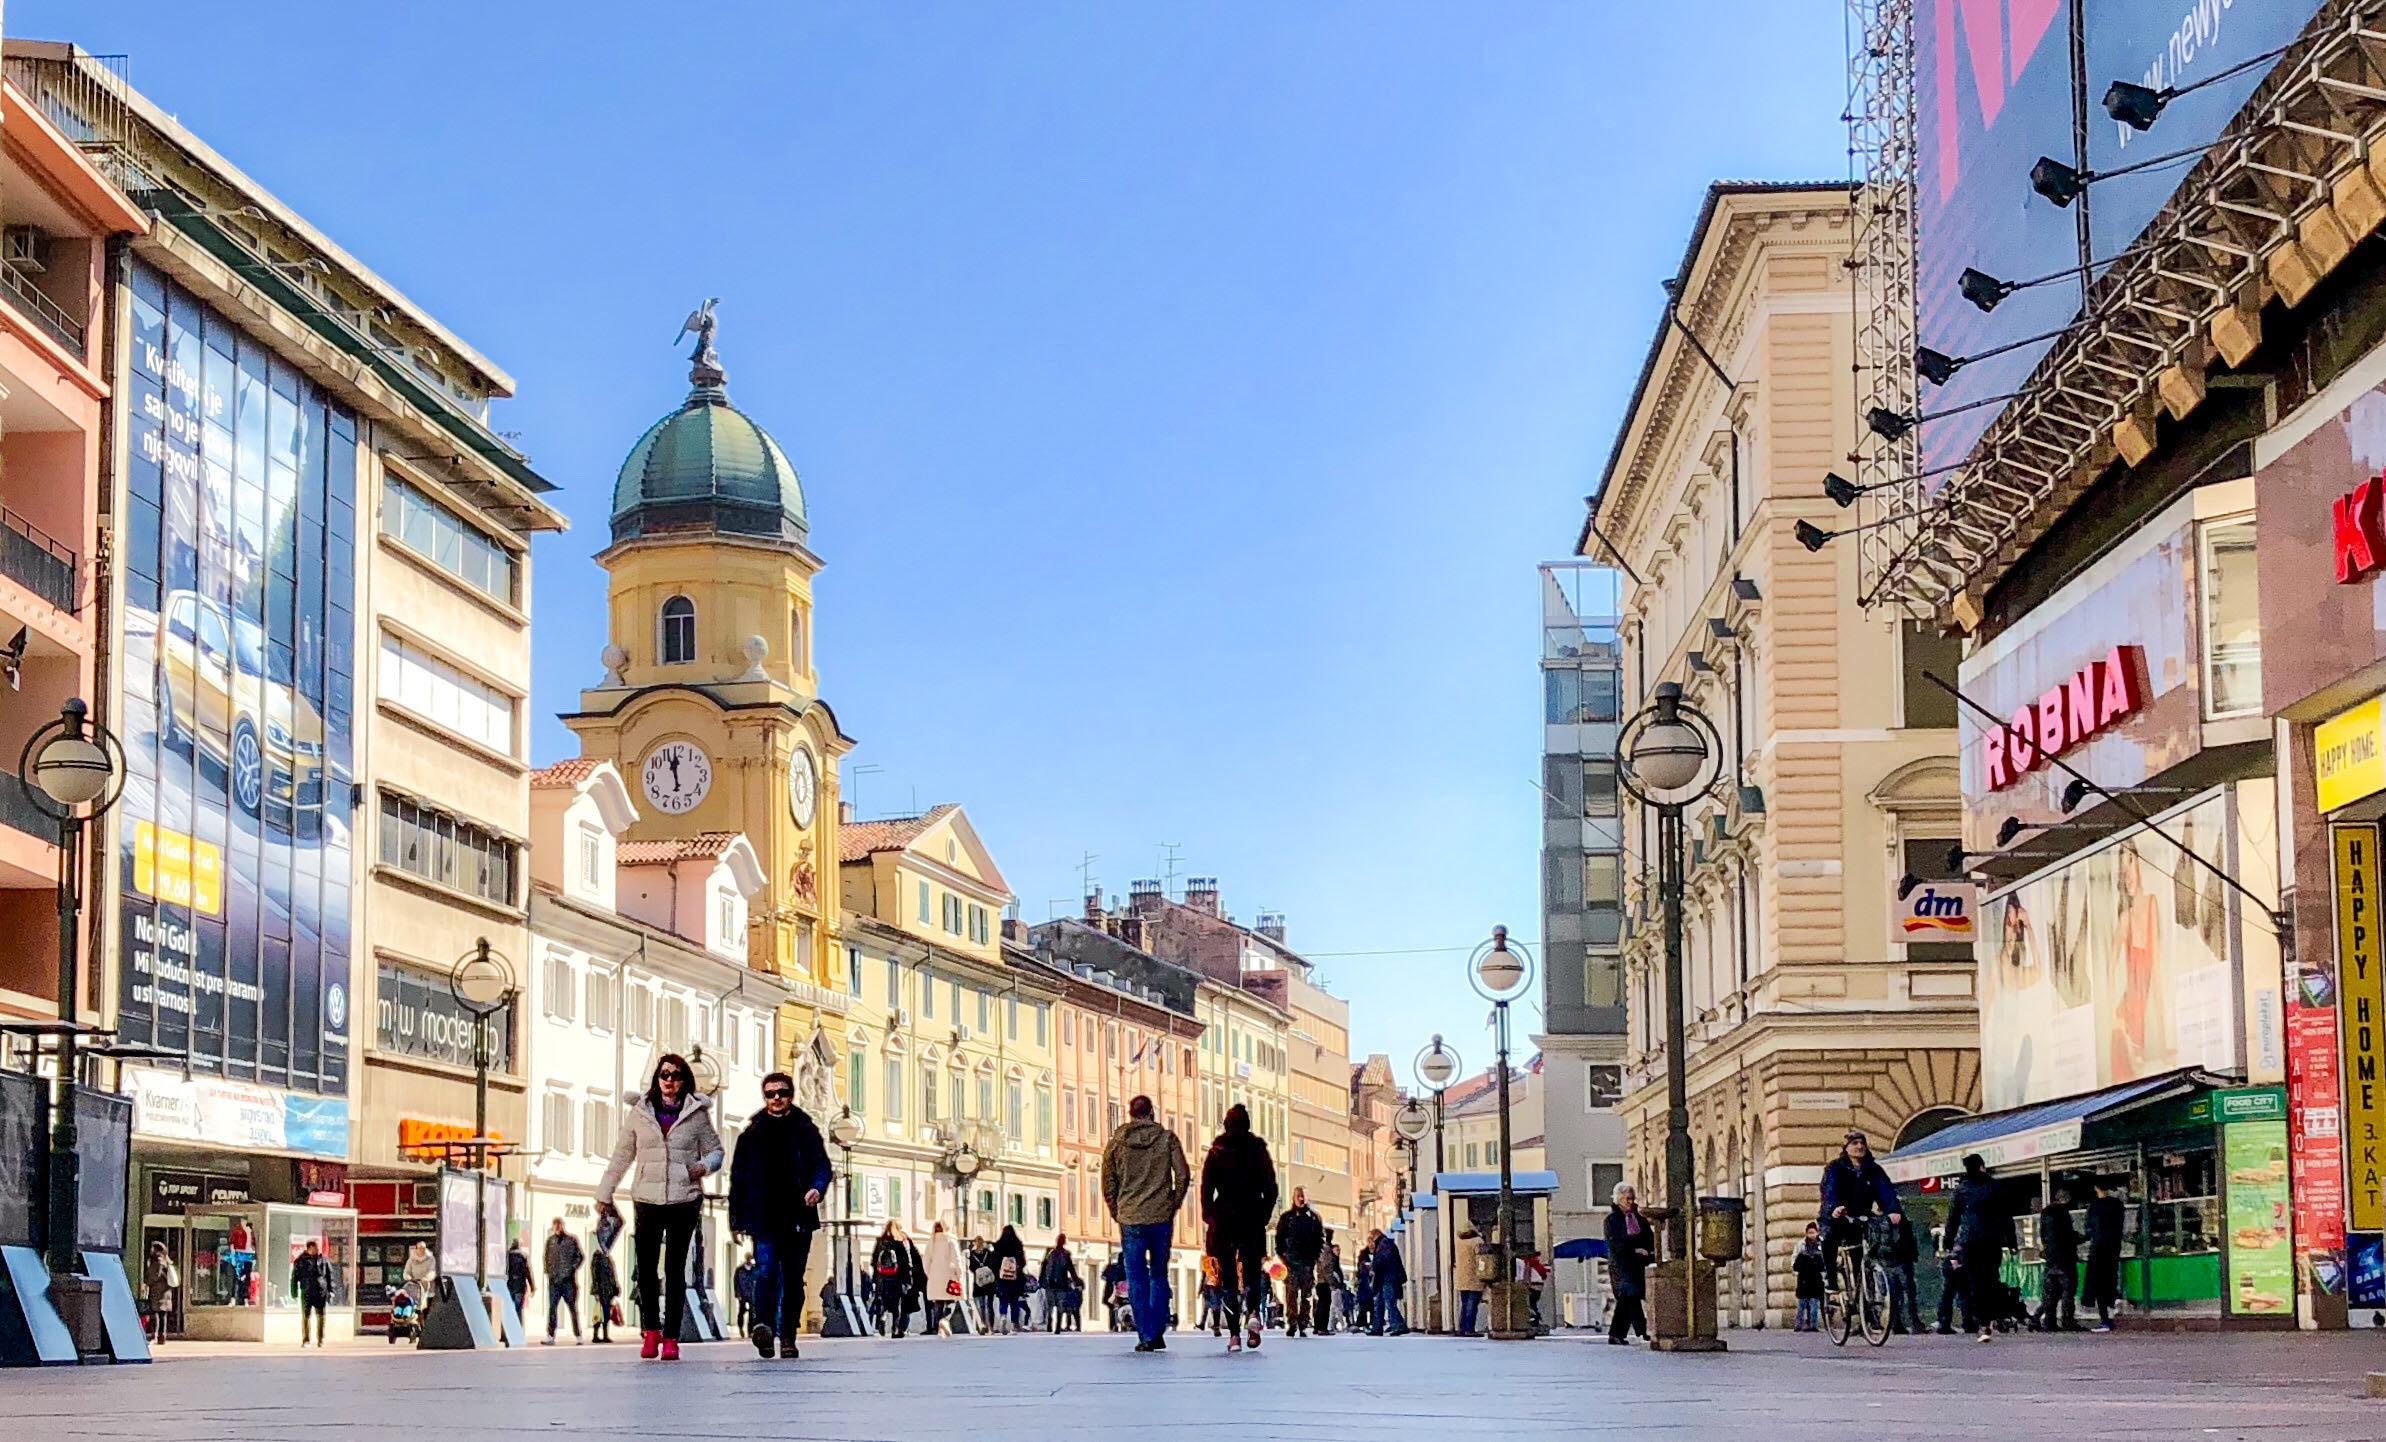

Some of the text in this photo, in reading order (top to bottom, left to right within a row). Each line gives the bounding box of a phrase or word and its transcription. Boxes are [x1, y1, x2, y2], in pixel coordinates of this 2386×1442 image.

[1984, 645, 2143, 792] ROBNA
[651, 756, 662, 770] 10
[694, 755, 702, 768] 2
[2320, 743, 2348, 778] HAPPY
[646, 771, 655, 785] 9
[699, 769, 708, 783] 3
[651, 785, 660, 800] 8
[693, 782, 702, 797] 4
[662, 794, 670, 808] 7
[671, 796, 680, 811] 6
[684, 793, 692, 807] 5
[1914, 888, 1963, 916] dm
[2349, 840, 2367, 979] HAPPY
[207, 973, 265, 1002] prevaram
[2358, 996, 2375, 1110] HOME
[2364, 1145, 2379, 1207] KAT
[564, 1203, 591, 1218] ZARA
